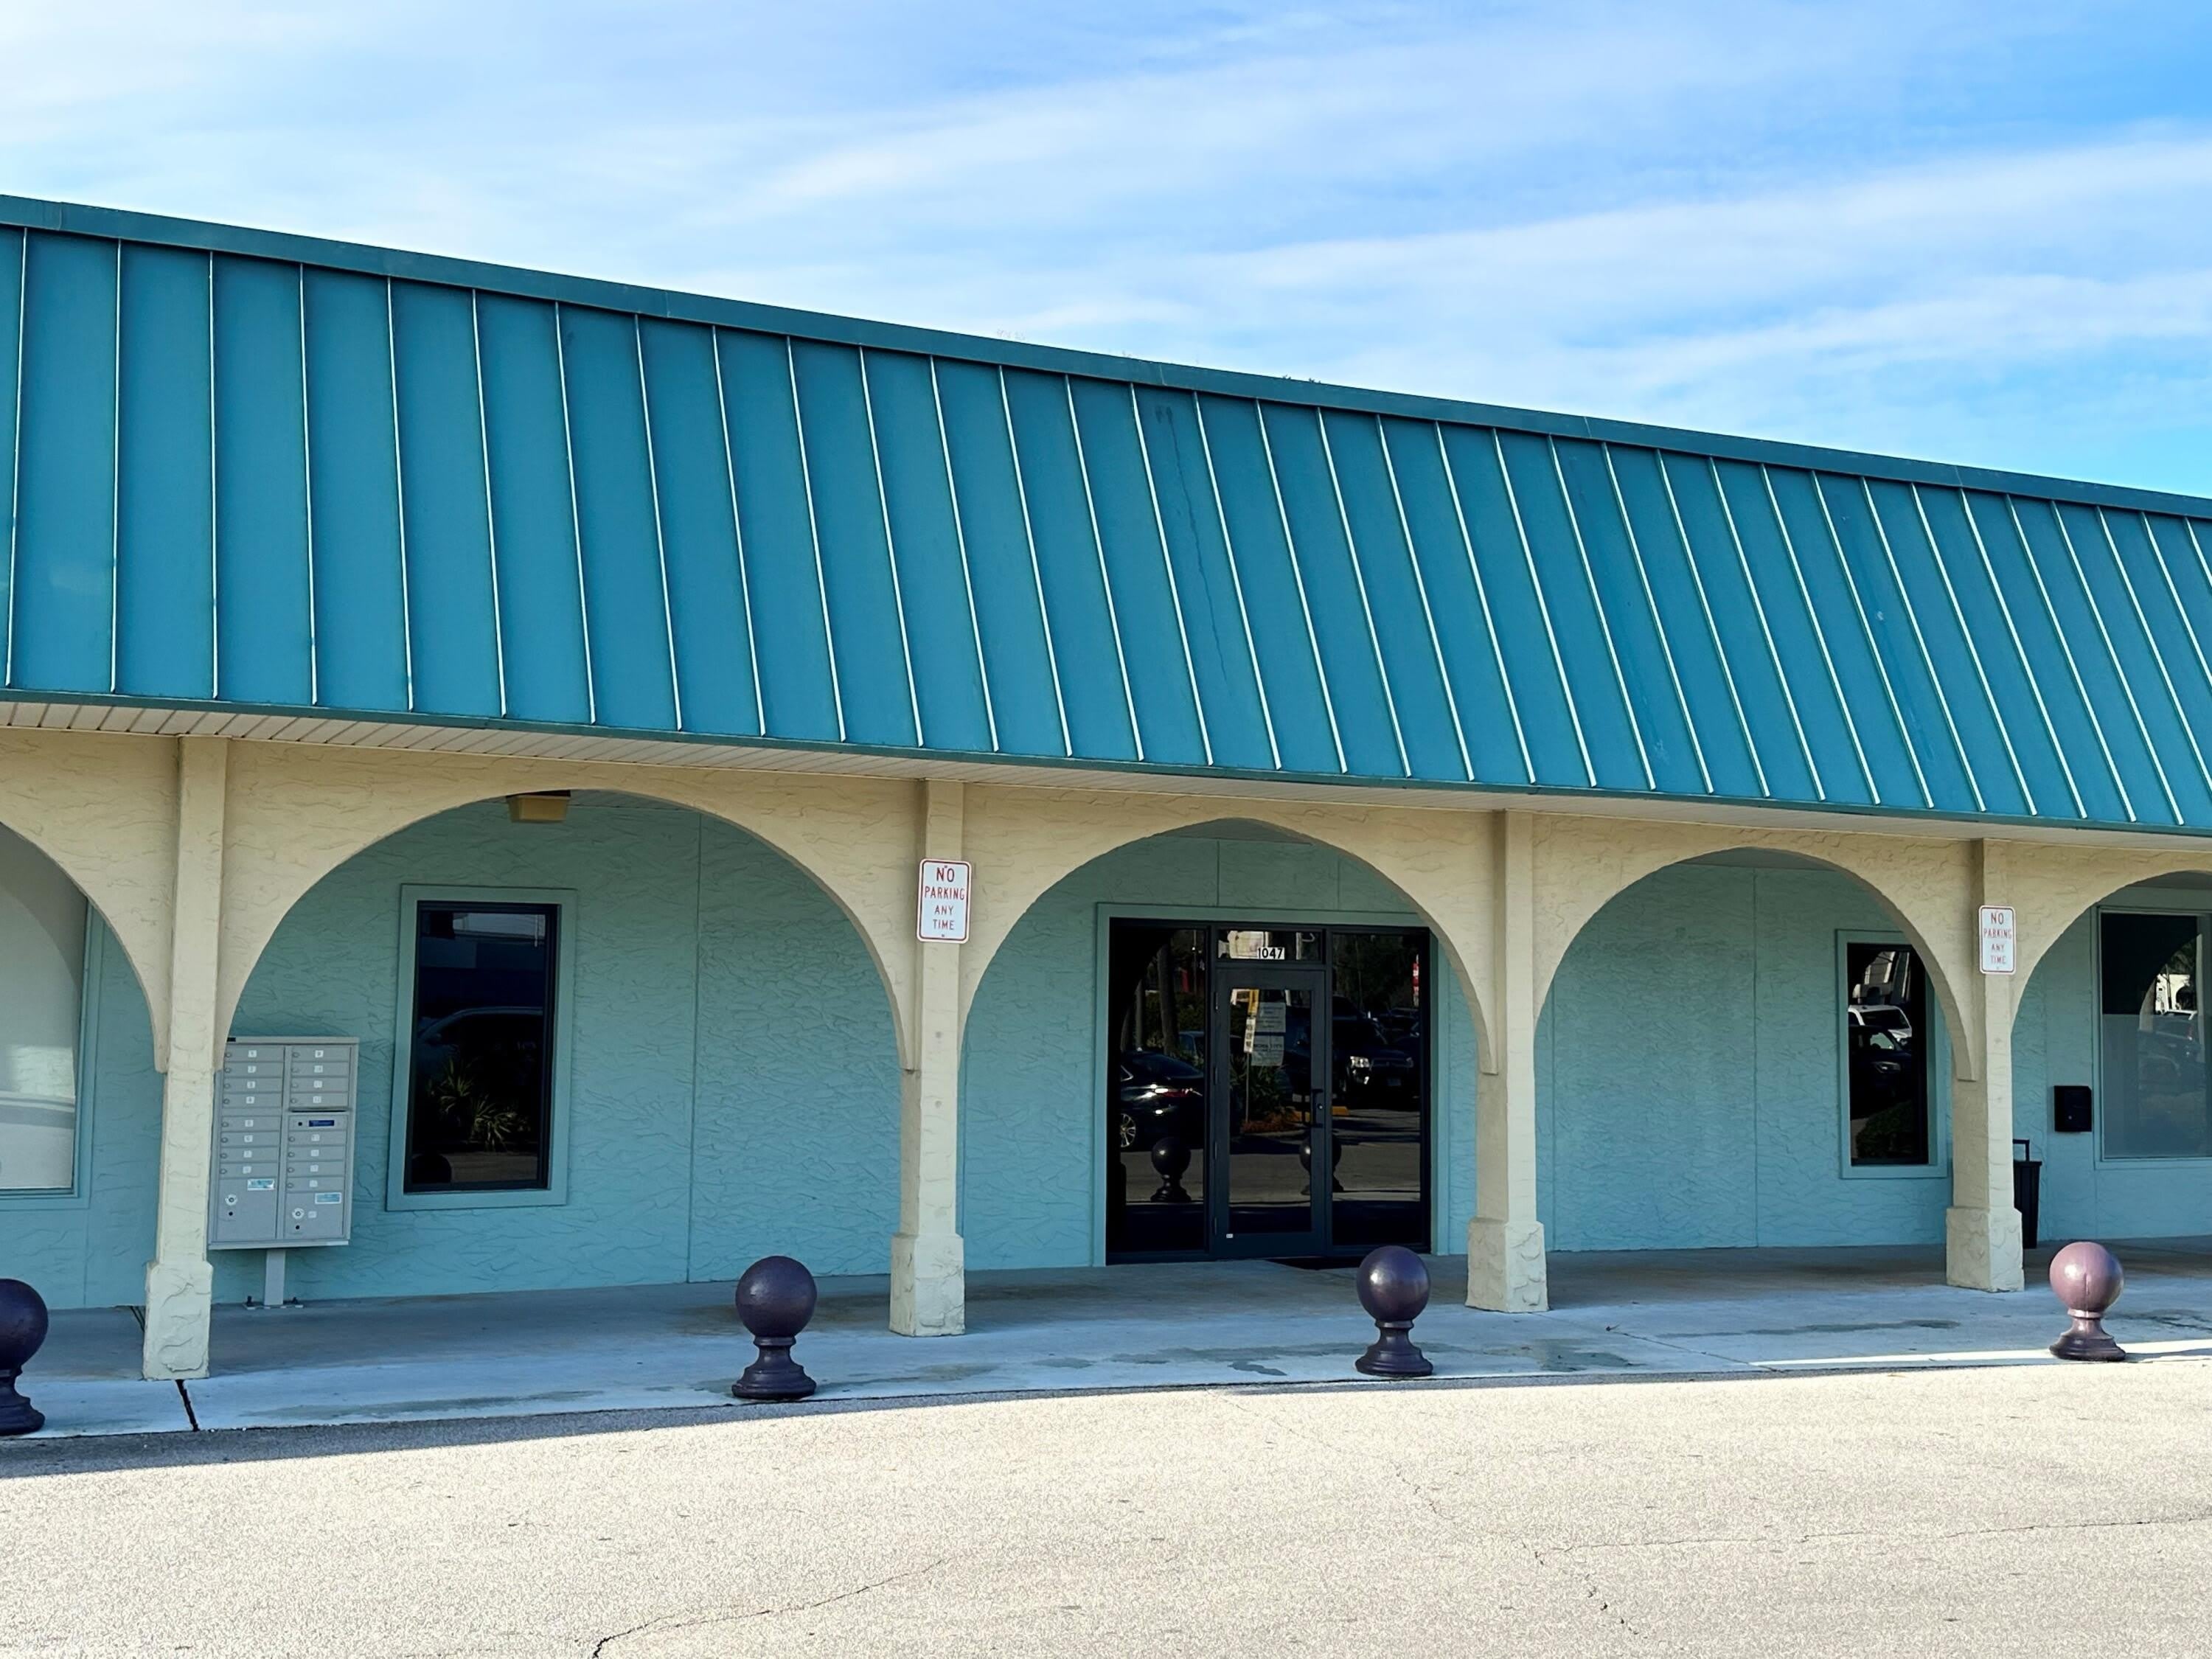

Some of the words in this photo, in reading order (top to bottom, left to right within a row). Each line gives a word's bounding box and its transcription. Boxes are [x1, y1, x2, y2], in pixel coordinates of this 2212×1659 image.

[936, 867, 955, 883] NO
[924, 886, 965, 900] PARKING
[934, 905, 953, 915] ANY
[933, 919, 955, 930] TIME
[1991, 913, 2004, 925] NO
[1983, 928, 2011, 939] PARKING
[1258, 947, 1283, 959] 1047
[1992, 944, 2004, 953] ANY
[1991, 956, 2006, 964] TIME
